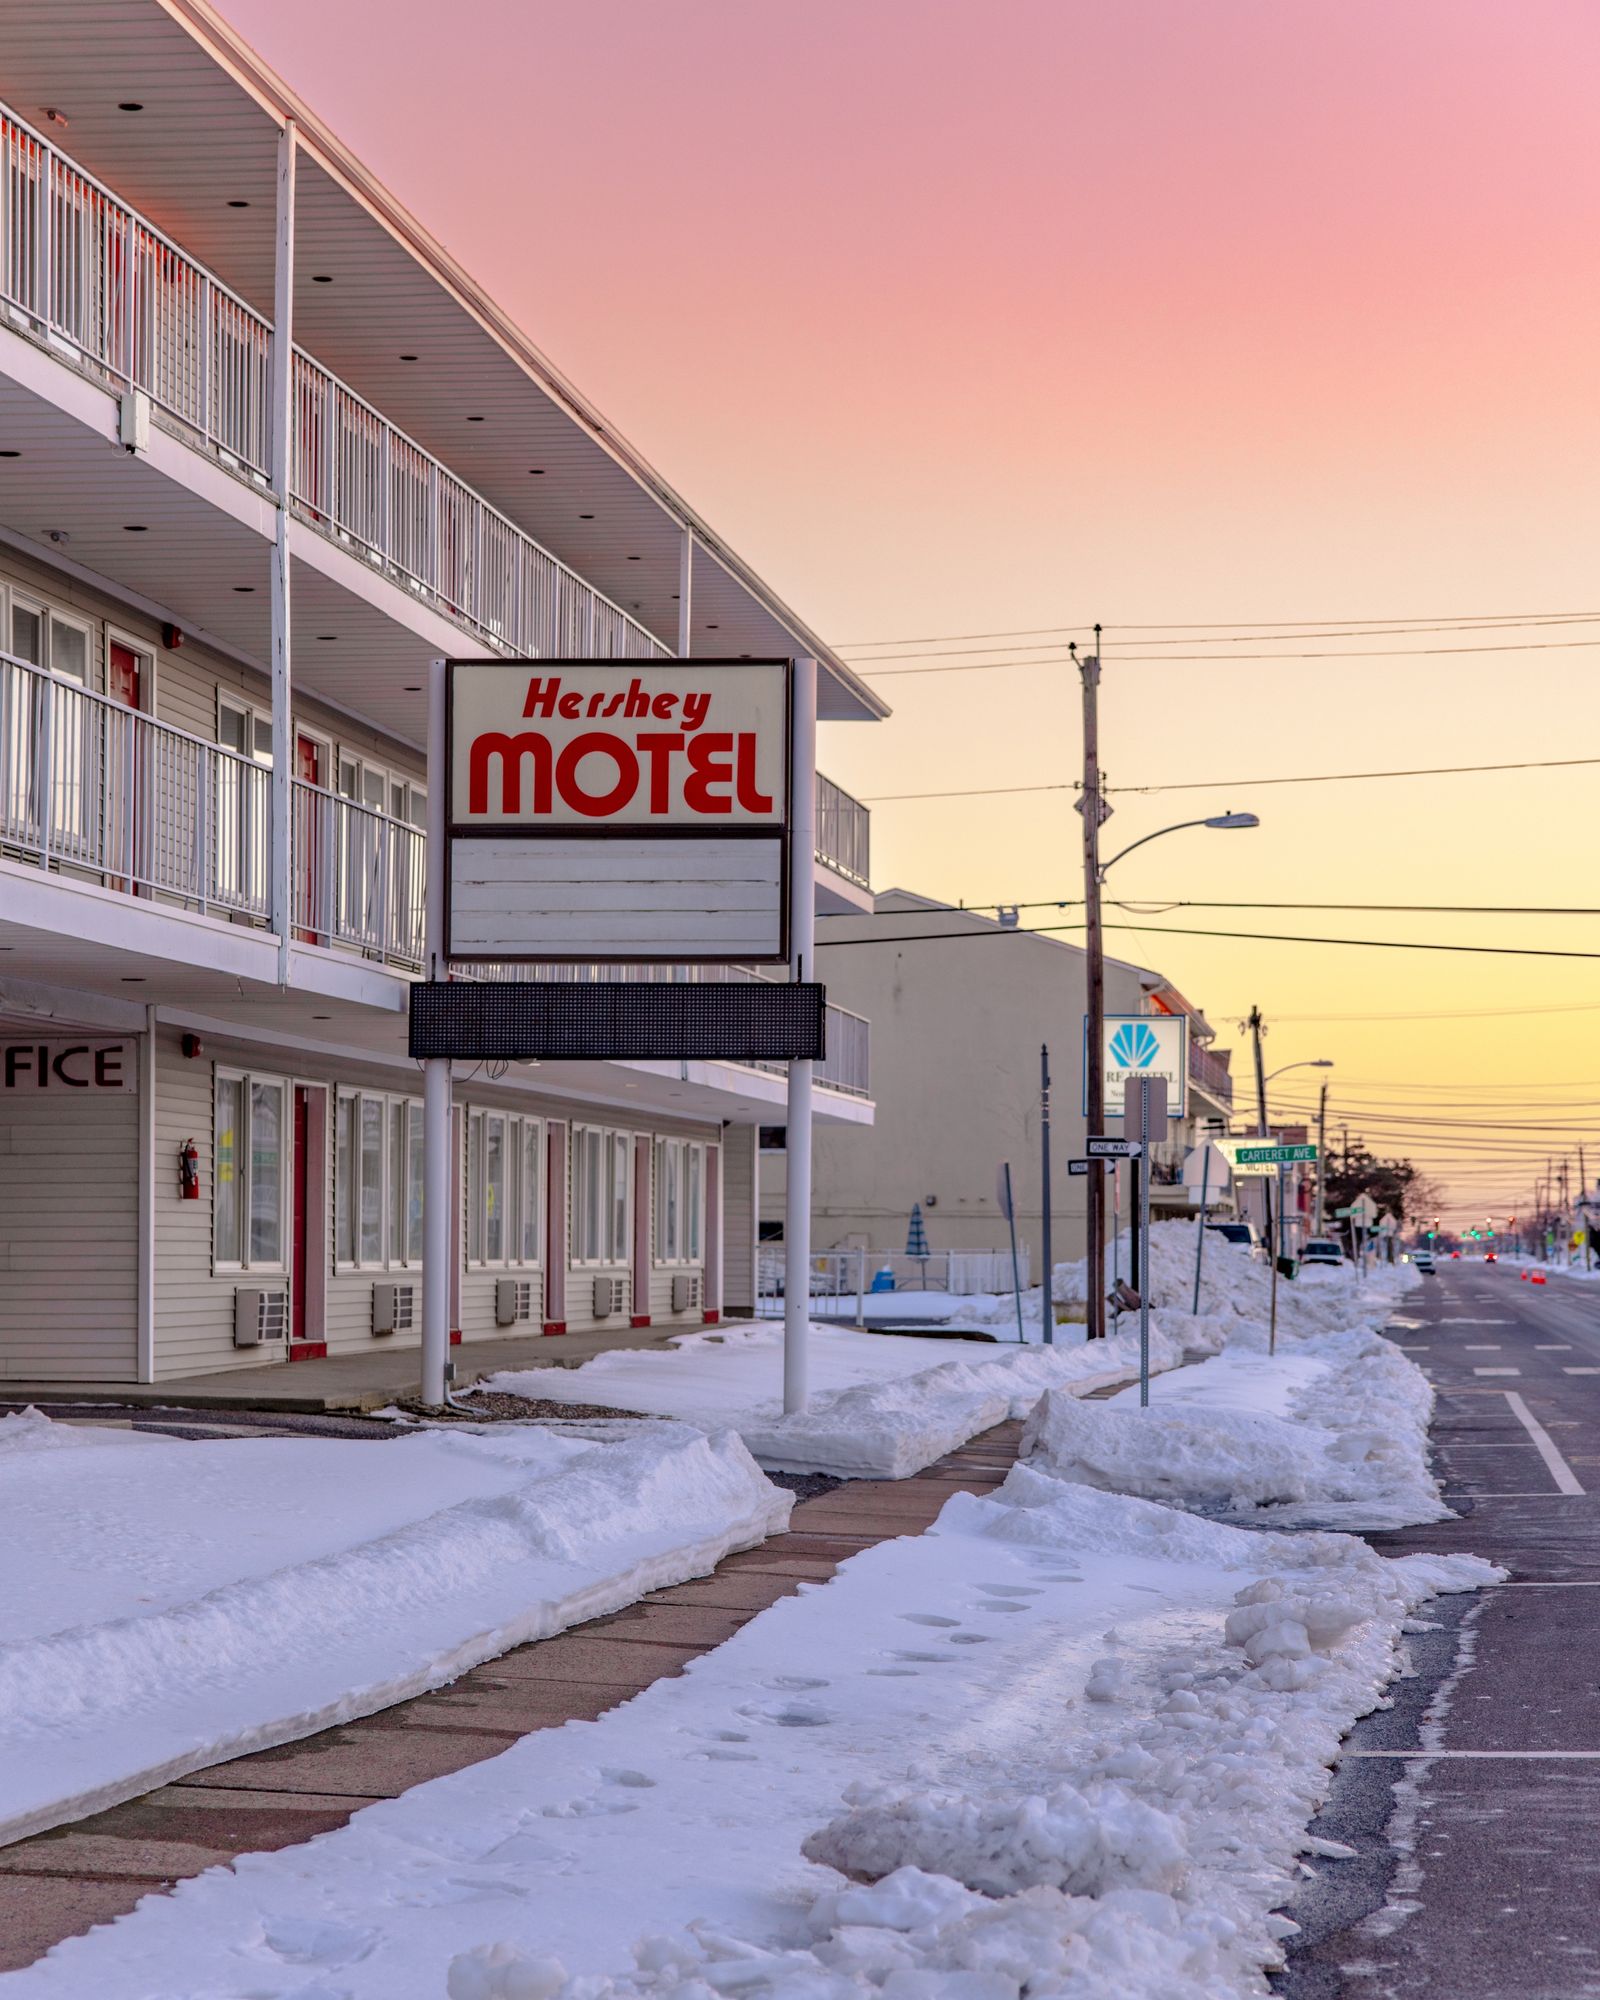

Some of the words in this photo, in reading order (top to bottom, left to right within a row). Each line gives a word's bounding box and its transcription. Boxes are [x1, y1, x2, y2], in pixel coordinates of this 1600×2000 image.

[522, 677, 712, 732] Hershey
[469, 731, 773, 817] MOTEL
[0, 1045, 123, 1087] FICE
[1091, 1143, 1109, 1152] ONE
[1112, 1143, 1129, 1152] WAY
[1241, 1148, 1289, 1162] CARTERET
[1293, 1147, 1311, 1159] AVE
